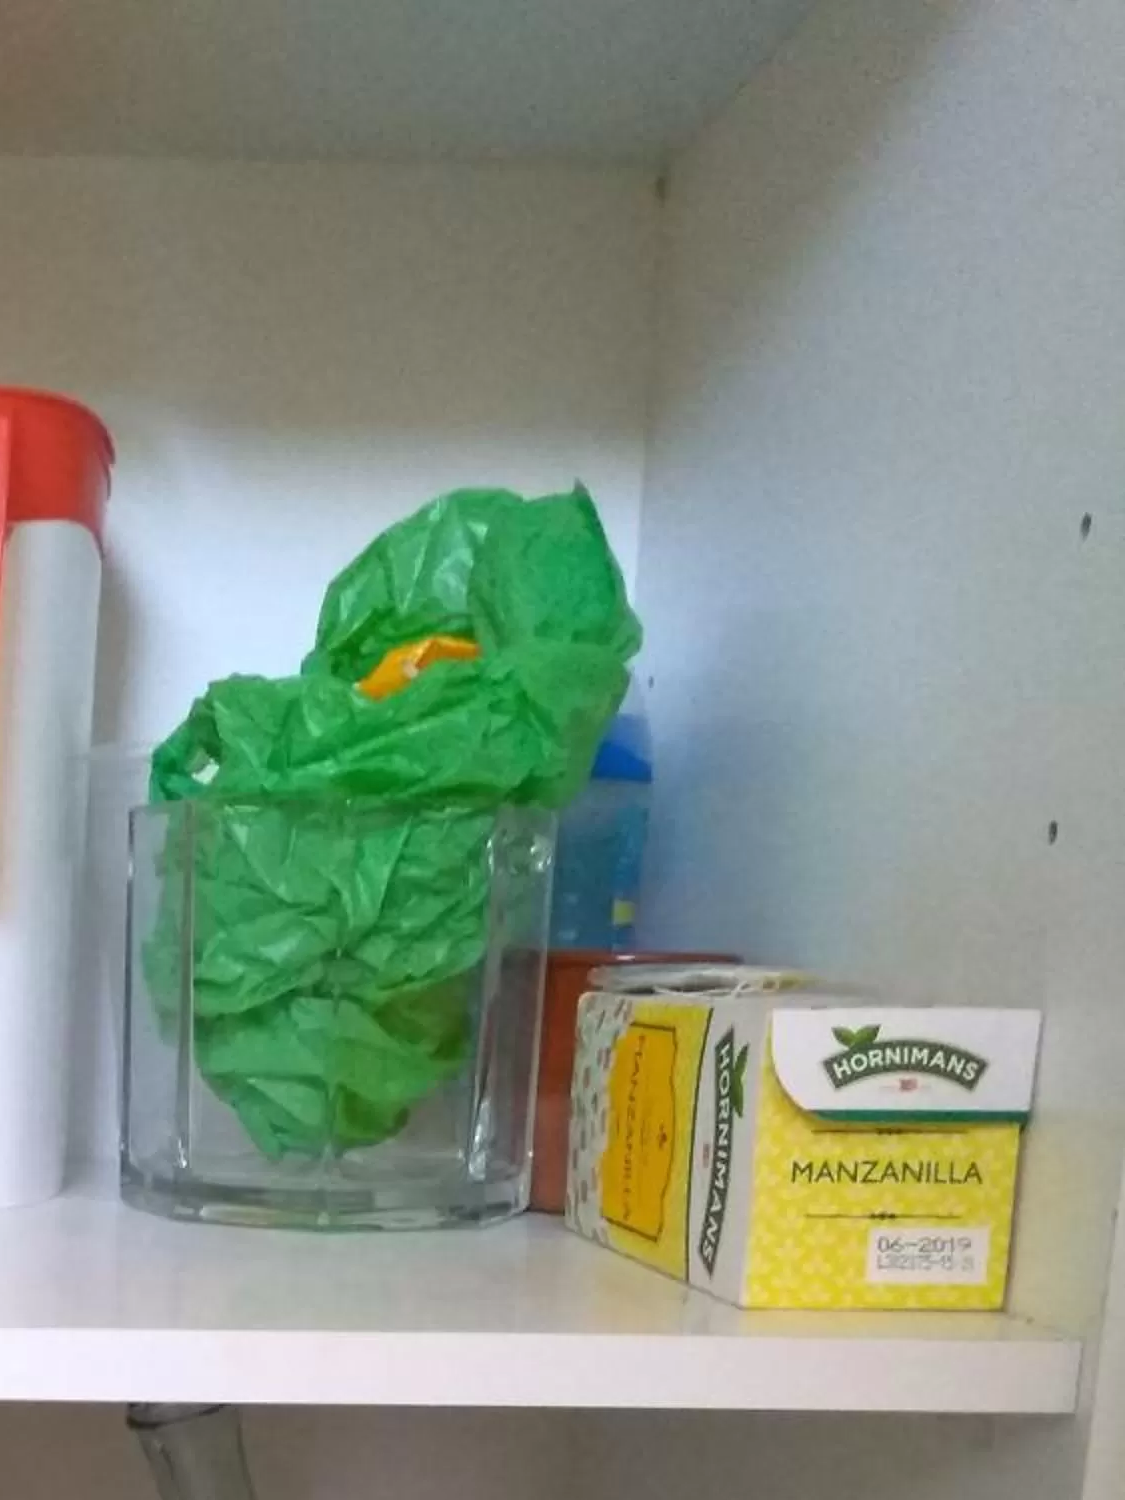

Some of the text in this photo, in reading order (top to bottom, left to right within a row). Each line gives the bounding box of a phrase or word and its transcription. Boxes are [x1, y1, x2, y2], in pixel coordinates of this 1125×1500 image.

[832, 1046, 979, 1081] HORNIMANS
[701, 1042, 733, 1263] HORNIMANS
[790, 1159, 984, 1185] MANZANILLA
